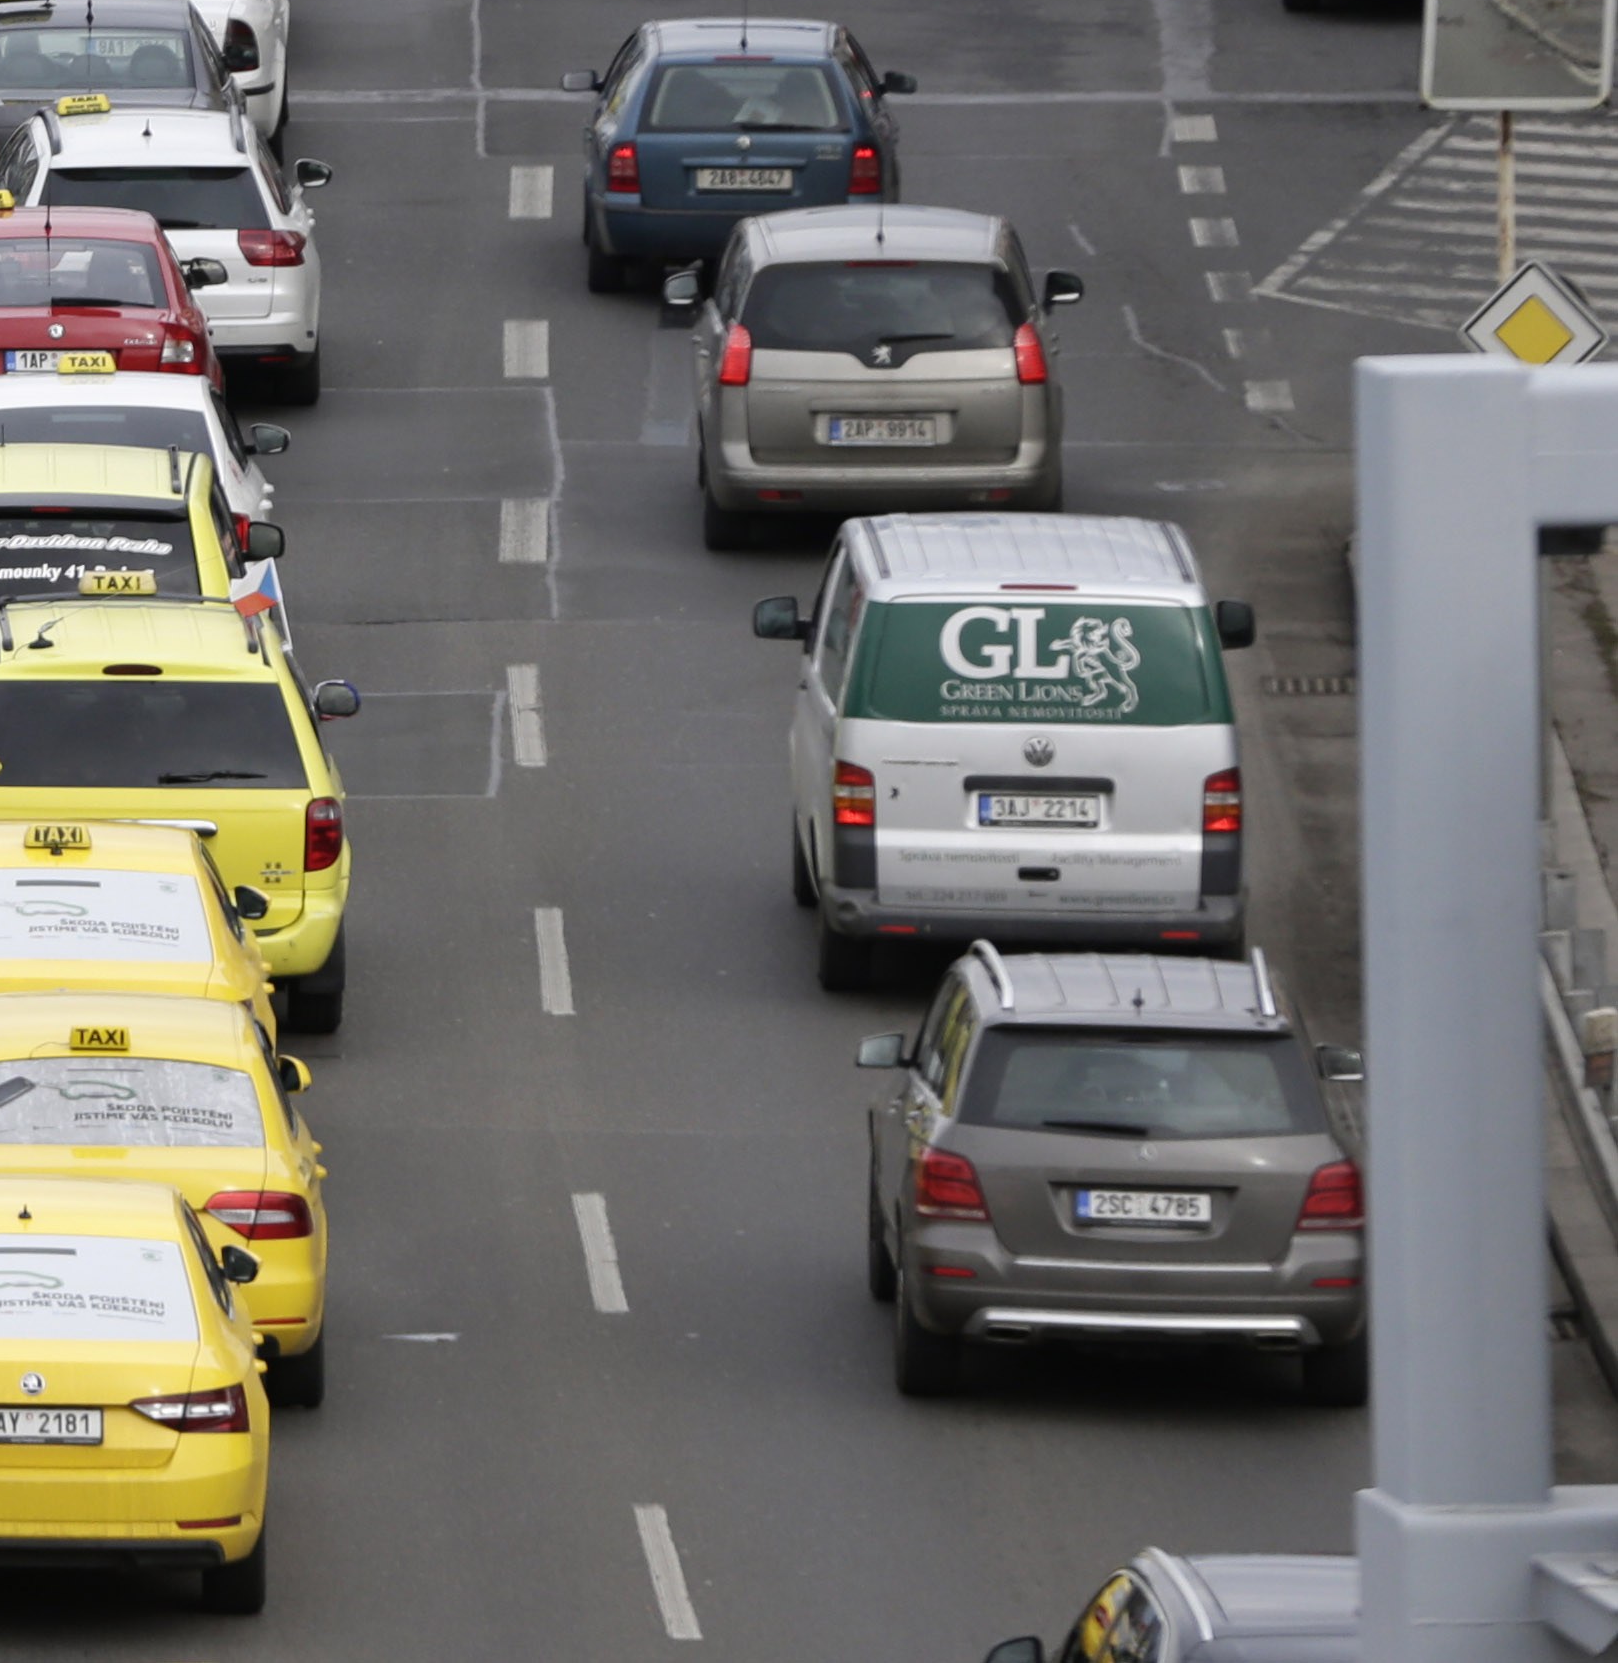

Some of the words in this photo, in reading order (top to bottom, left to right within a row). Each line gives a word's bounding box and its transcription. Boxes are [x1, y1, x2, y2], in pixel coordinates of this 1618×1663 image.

[20, 352, 47, 368] 1AP
[68, 356, 106, 368] TAXI
[106, 534, 173, 555] Praha
[93, 576, 140, 591] TAXI
[940, 606, 1070, 679] GL
[994, 798, 1027, 818] 3AJ
[1043, 798, 1088, 818] 2214
[36, 826, 82, 843] TAXI
[75, 1028, 124, 1045] TAXI
[1094, 1195, 1133, 1217] 2SC
[1148, 1195, 1201, 1217] 4785
[39, 1411, 91, 1434] 2181
